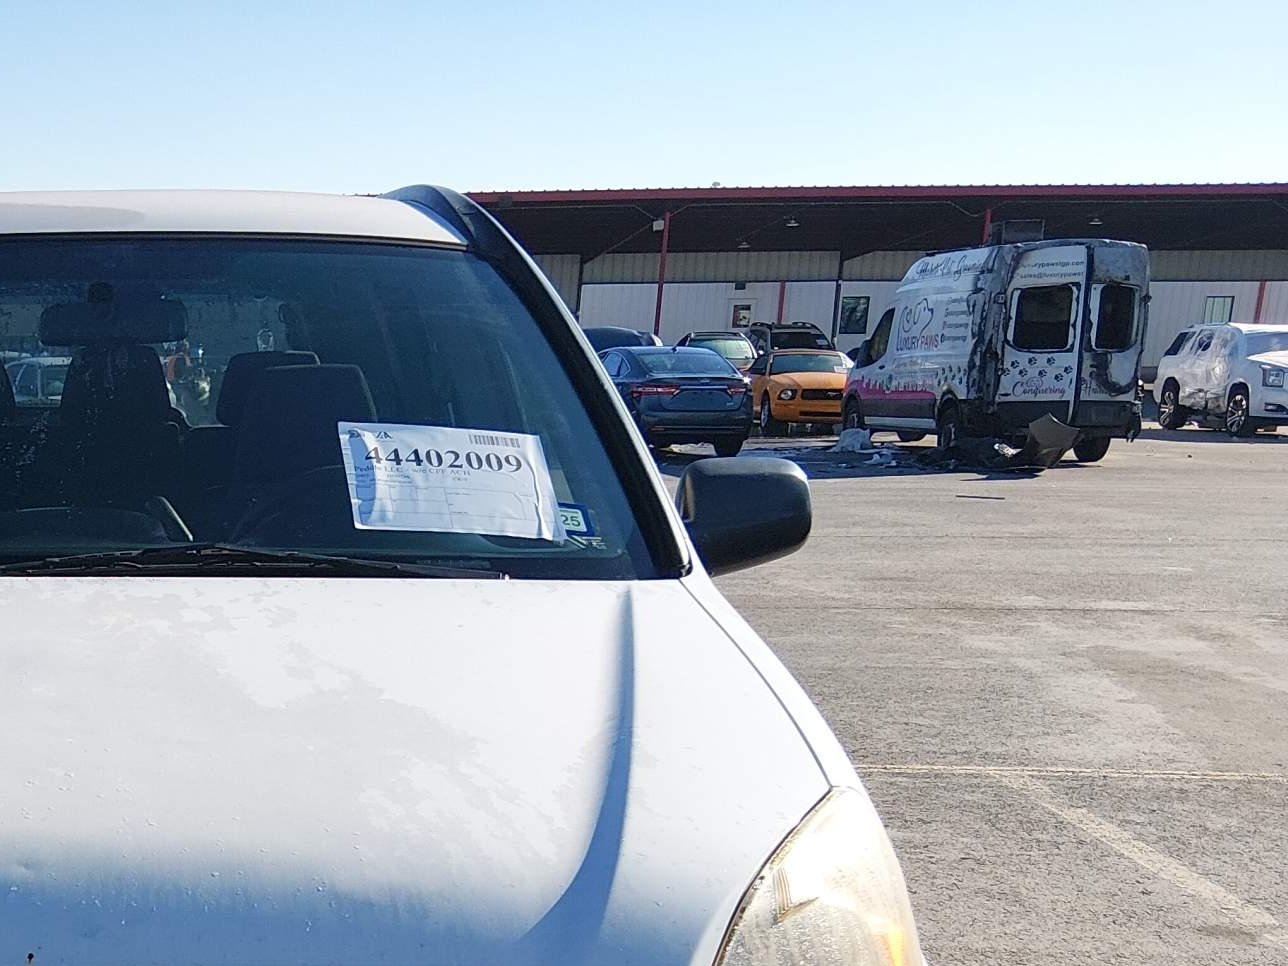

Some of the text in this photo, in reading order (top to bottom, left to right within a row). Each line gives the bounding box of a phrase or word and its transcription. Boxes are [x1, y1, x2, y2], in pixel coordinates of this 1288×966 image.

[920, 333, 939, 350] PAWS
[1013, 381, 1066, 398] Conquering
[365, 446, 522, 473] 44402009
[560, 514, 581, 527] 25
